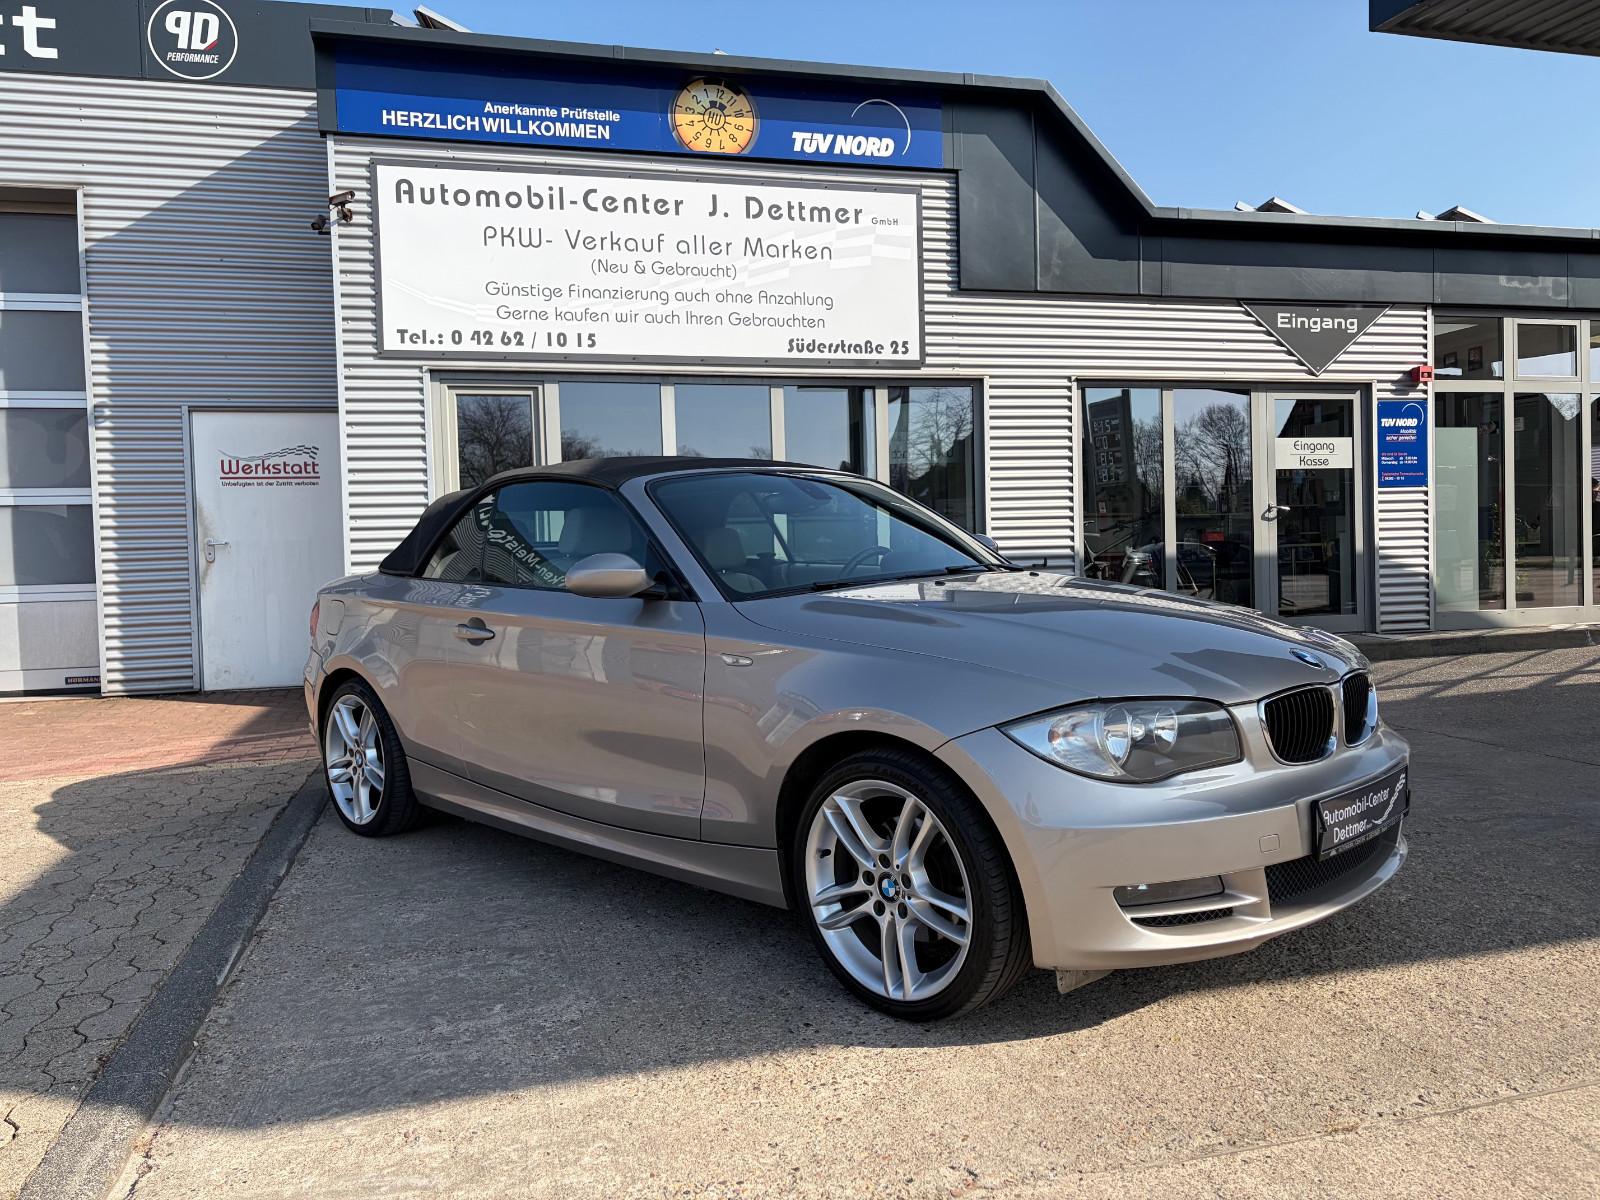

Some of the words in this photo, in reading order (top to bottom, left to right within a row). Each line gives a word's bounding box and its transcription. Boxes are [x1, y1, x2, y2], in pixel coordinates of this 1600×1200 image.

[0, 5, 58, 59] t
[166, 51, 219, 64] PERFORMANCE
[692, 94, 702, 105] 2
[716, 88, 725, 100] 12
[726, 95, 737, 107] 11
[484, 101, 558, 118] Anerkannte
[561, 107, 621, 122] Prüfstelle
[685, 106, 695, 114] 3
[707, 111, 722, 126] HU
[734, 109, 745, 118] 10
[382, 109, 480, 131] HERZLICH
[482, 117, 610, 140] WILLKOMMEN
[692, 131, 702, 141] 5
[728, 133, 738, 143] 8
[792, 131, 834, 154] TÜV
[834, 135, 895, 157] NORD
[395, 178, 683, 216] Automobil-Center
[708, 194, 729, 218] J.
[745, 195, 864, 225] Dettmer
[871, 217, 899, 226] GmbH
[483, 225, 553, 249] PKW-
[564, 228, 665, 254] Verkauf
[676, 234, 733, 256] aller
[743, 237, 833, 260] Marken
[591, 258, 629, 276] (Neu
[634, 260, 646, 275] &
[651, 260, 737, 281] Gebraucht)
[485, 280, 563, 302] Günstige
[674, 289, 710, 303] auch
[715, 290, 753, 304] ohne
[759, 290, 834, 311] Anzahlung
[496, 304, 549, 321] Gerne
[554, 306, 609, 323] kaufen
[615, 310, 639, 324] wir
[644, 311, 681, 325] auch
[686, 311, 723, 326] Ihren
[728, 312, 826, 329] Gebrauchten
[1277, 313, 1358, 333] Eingang
[396, 328, 444, 345] Tel.:
[451, 330, 462, 345] 0
[470, 330, 494, 346] 42
[500, 330, 525, 347] 62
[531, 331, 537, 349] /
[546, 332, 567, 348] 10
[577, 332, 597, 348] 15
[787, 338, 884, 355] Süderstraße
[890, 340, 909, 355] 25
[1396, 418, 1418, 427] NORD
[1293, 440, 1335, 453] Eingang
[220, 459, 319, 475] Werkstatt
[1299, 456, 1329, 467] Kasse
[1323, 787, 1390, 826] Automobil-Center
[1333, 818, 1367, 843] Dettmer
